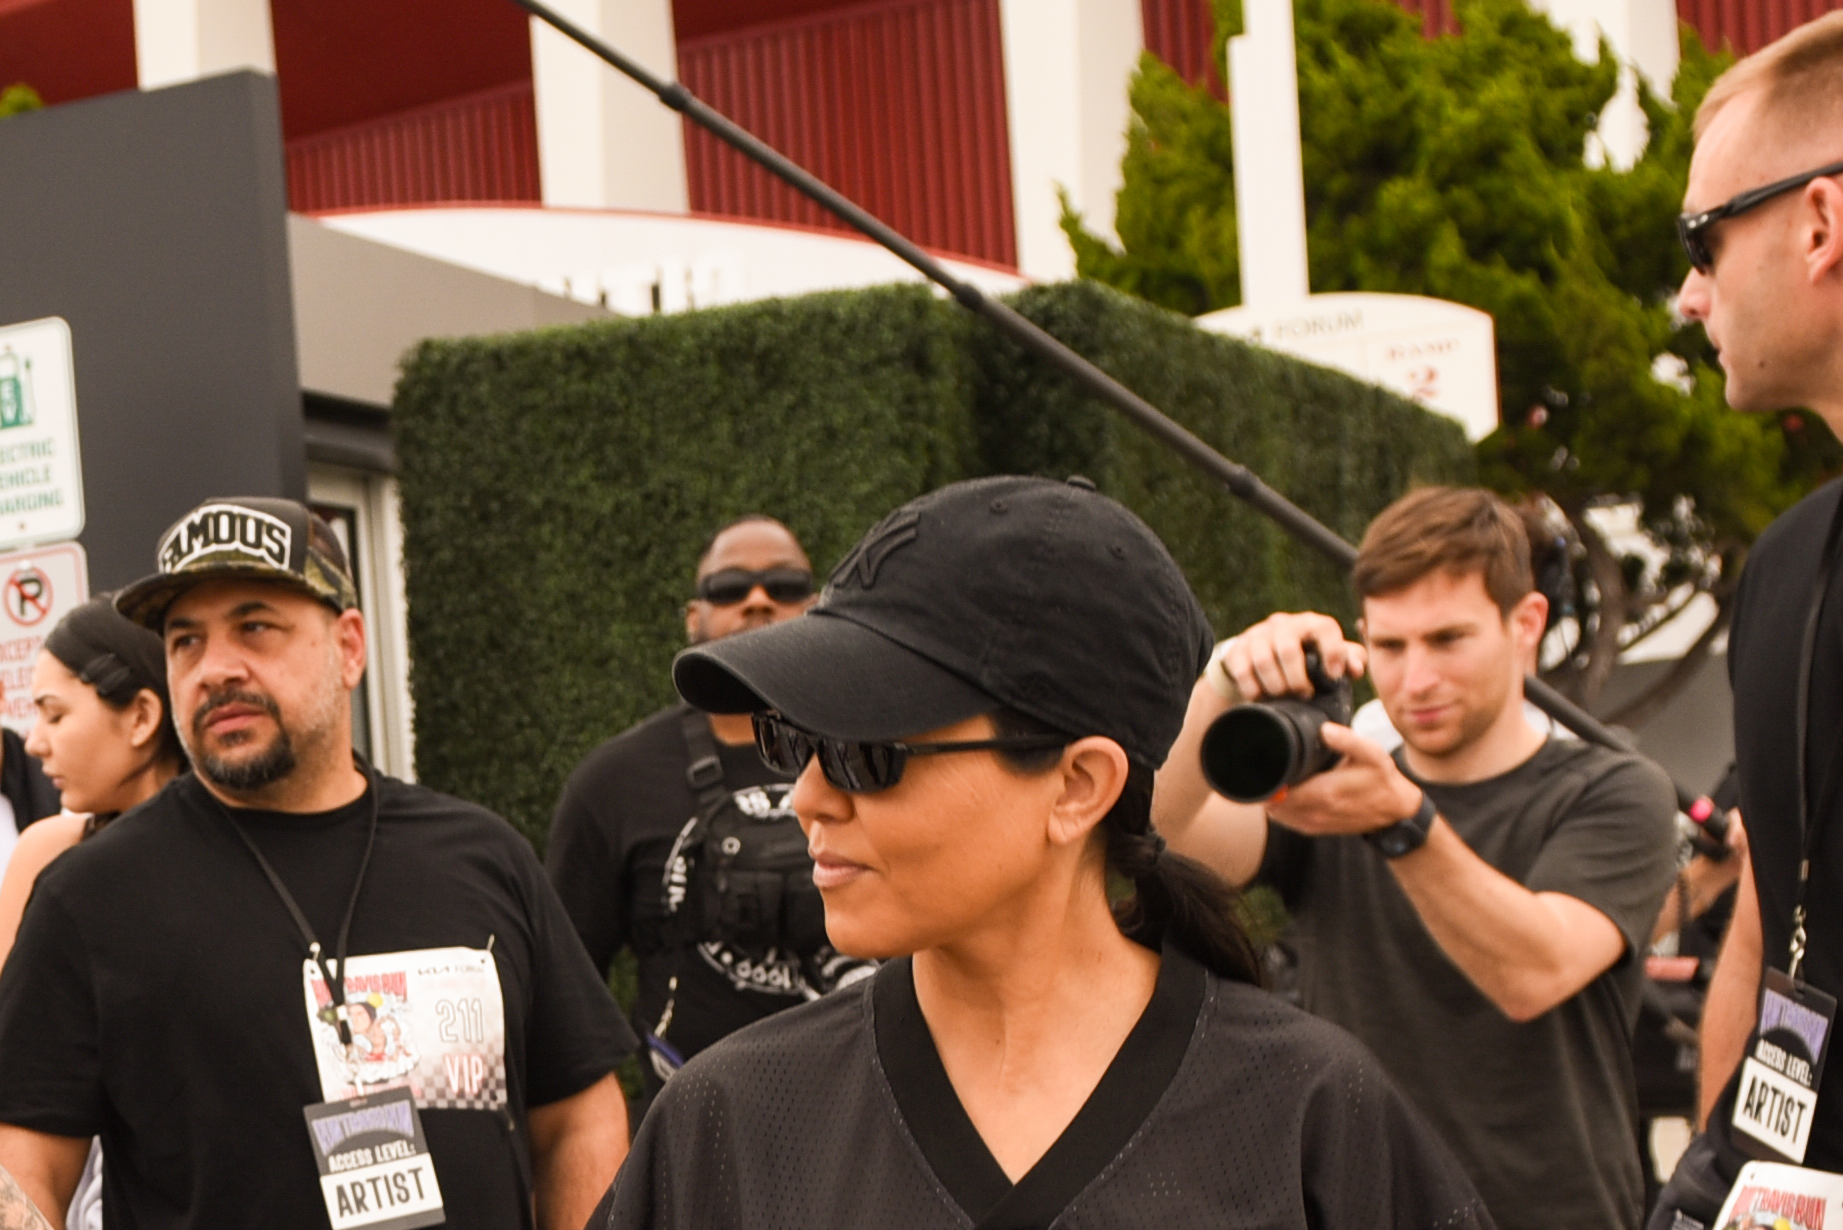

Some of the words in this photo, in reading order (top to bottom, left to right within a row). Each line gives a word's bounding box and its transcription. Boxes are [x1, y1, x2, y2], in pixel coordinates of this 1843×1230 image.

[435, 998, 484, 1043] 211
[444, 1054, 485, 1094] VIP
[1743, 1076, 1808, 1144] ARTIST
[328, 1148, 374, 1172] ACCESS
[374, 1140, 417, 1163] LEVEL:
[335, 1167, 425, 1217] ARTIST
